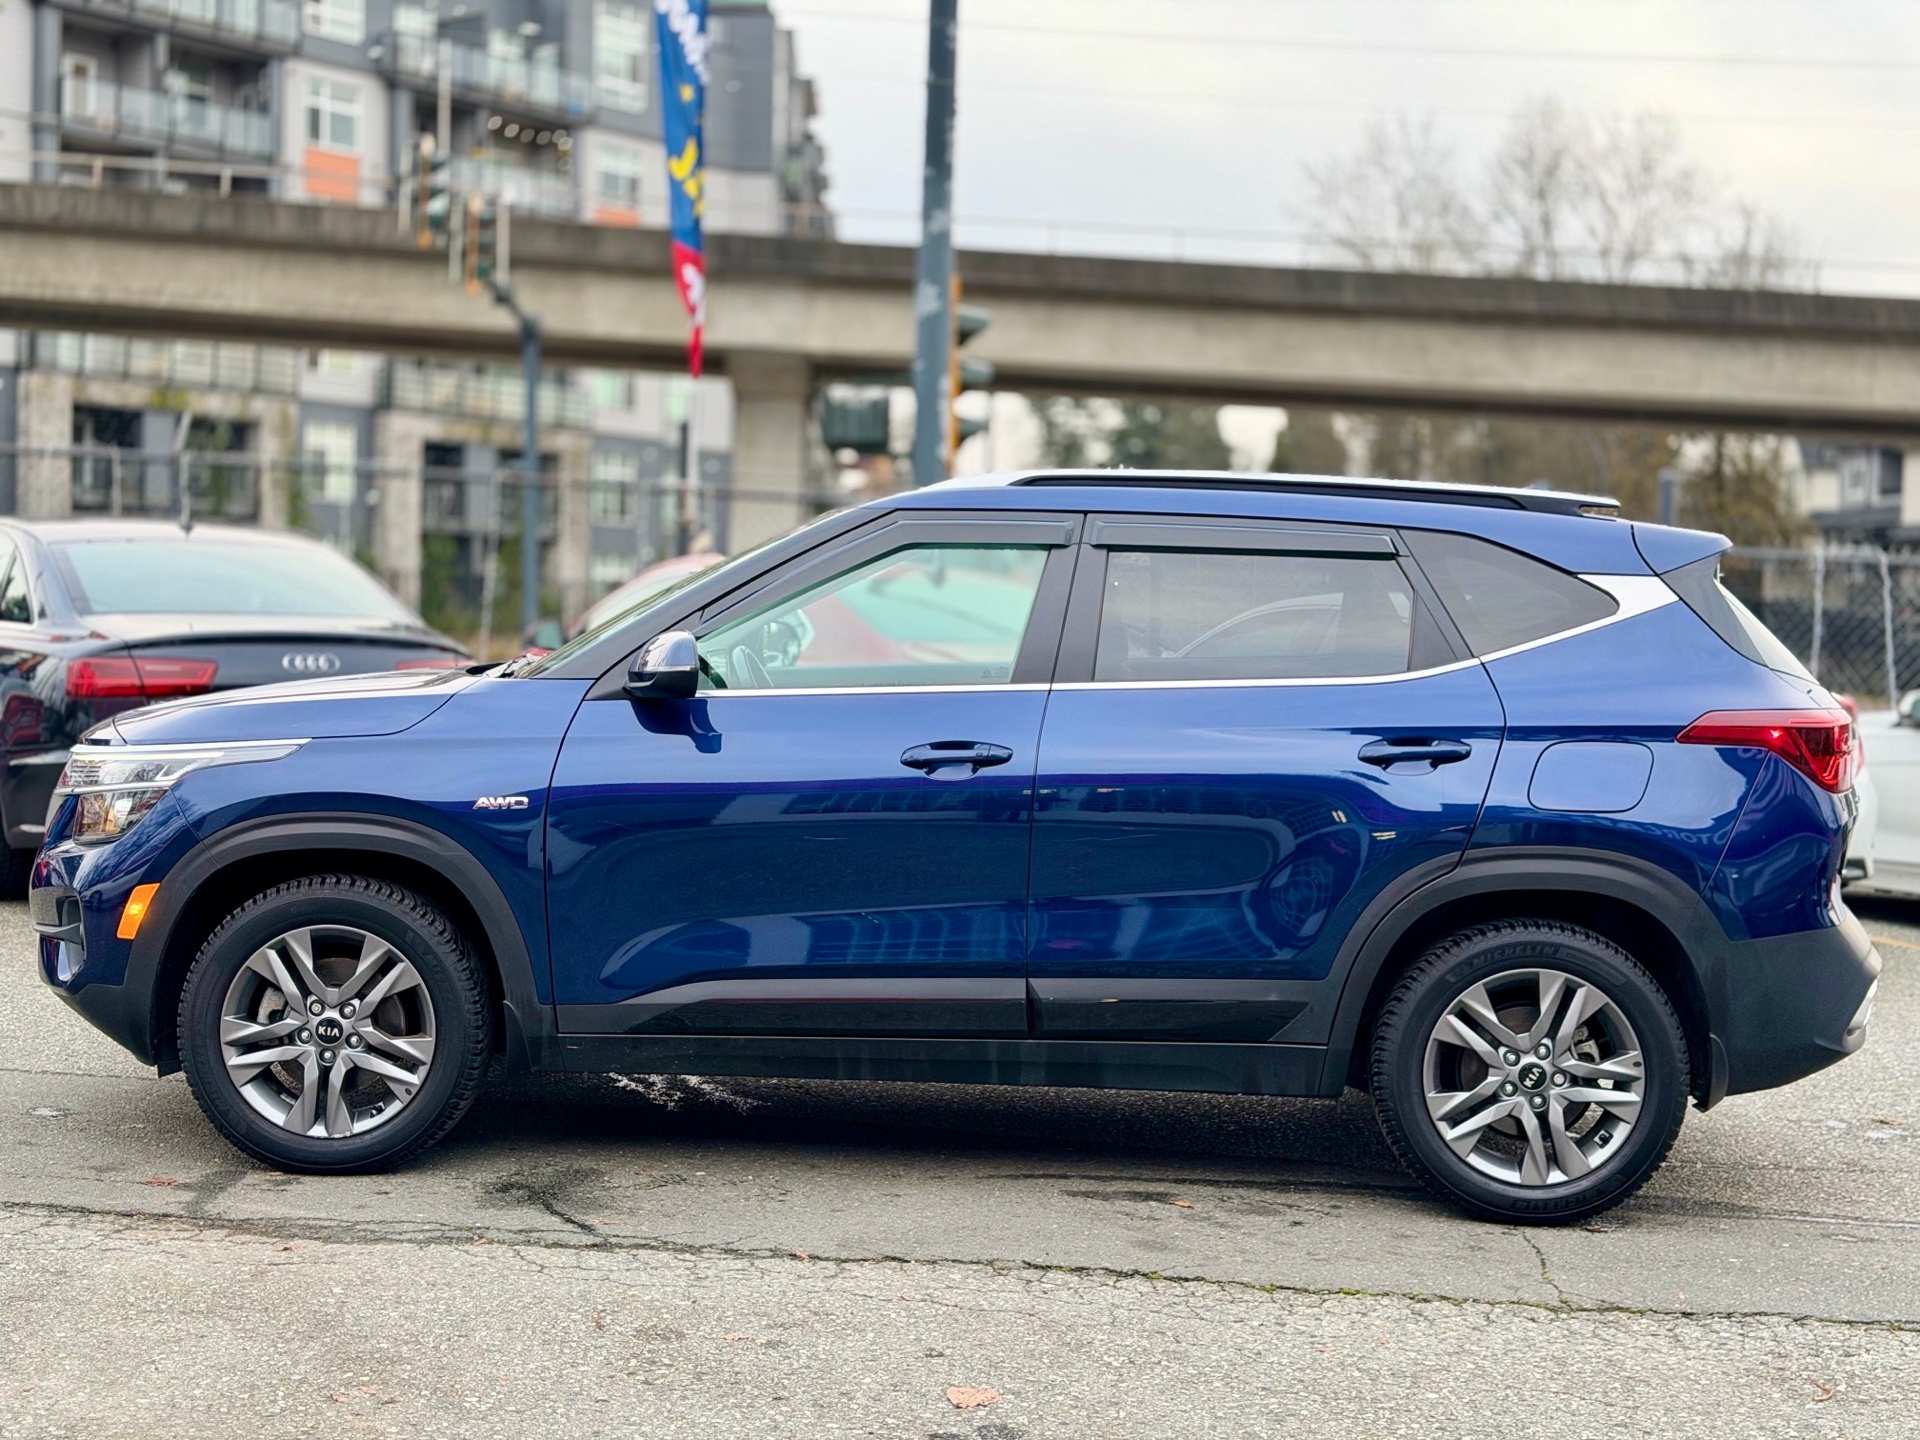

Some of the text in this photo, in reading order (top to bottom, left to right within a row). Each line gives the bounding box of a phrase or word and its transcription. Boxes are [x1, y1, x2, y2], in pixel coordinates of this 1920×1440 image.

[472, 796, 529, 810] AWD
[1472, 945, 1554, 967] MICHELIN
[318, 1025, 340, 1038] KIA
[1523, 1067, 1543, 1088] KIA
